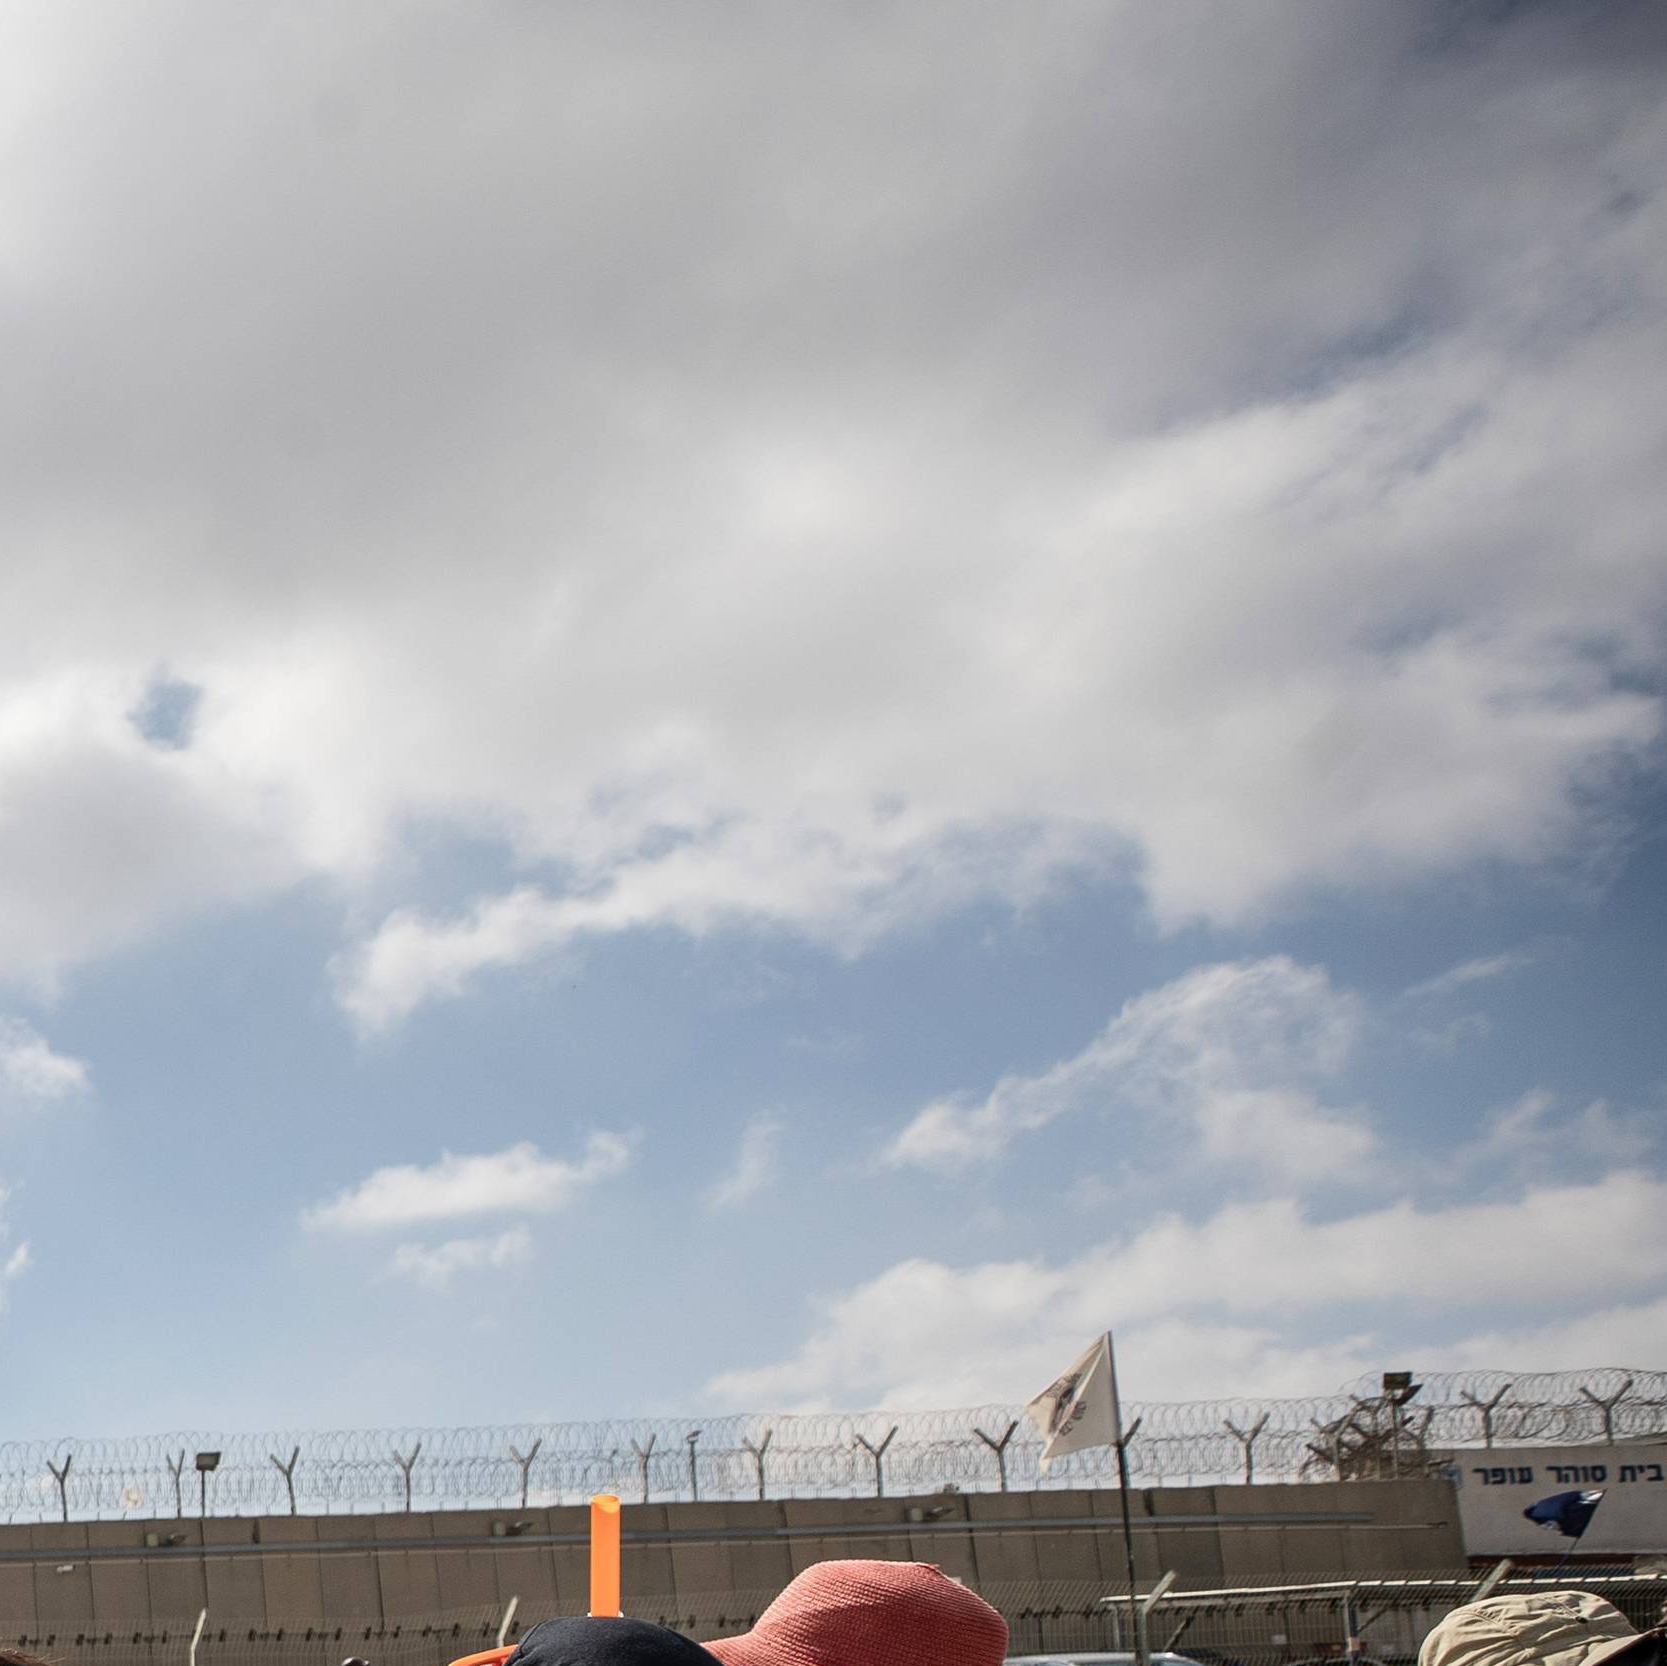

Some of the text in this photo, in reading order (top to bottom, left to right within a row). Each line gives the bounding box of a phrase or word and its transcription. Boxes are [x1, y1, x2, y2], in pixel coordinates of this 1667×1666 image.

[1473, 1464, 1664, 1485] בית סוהר עופר
